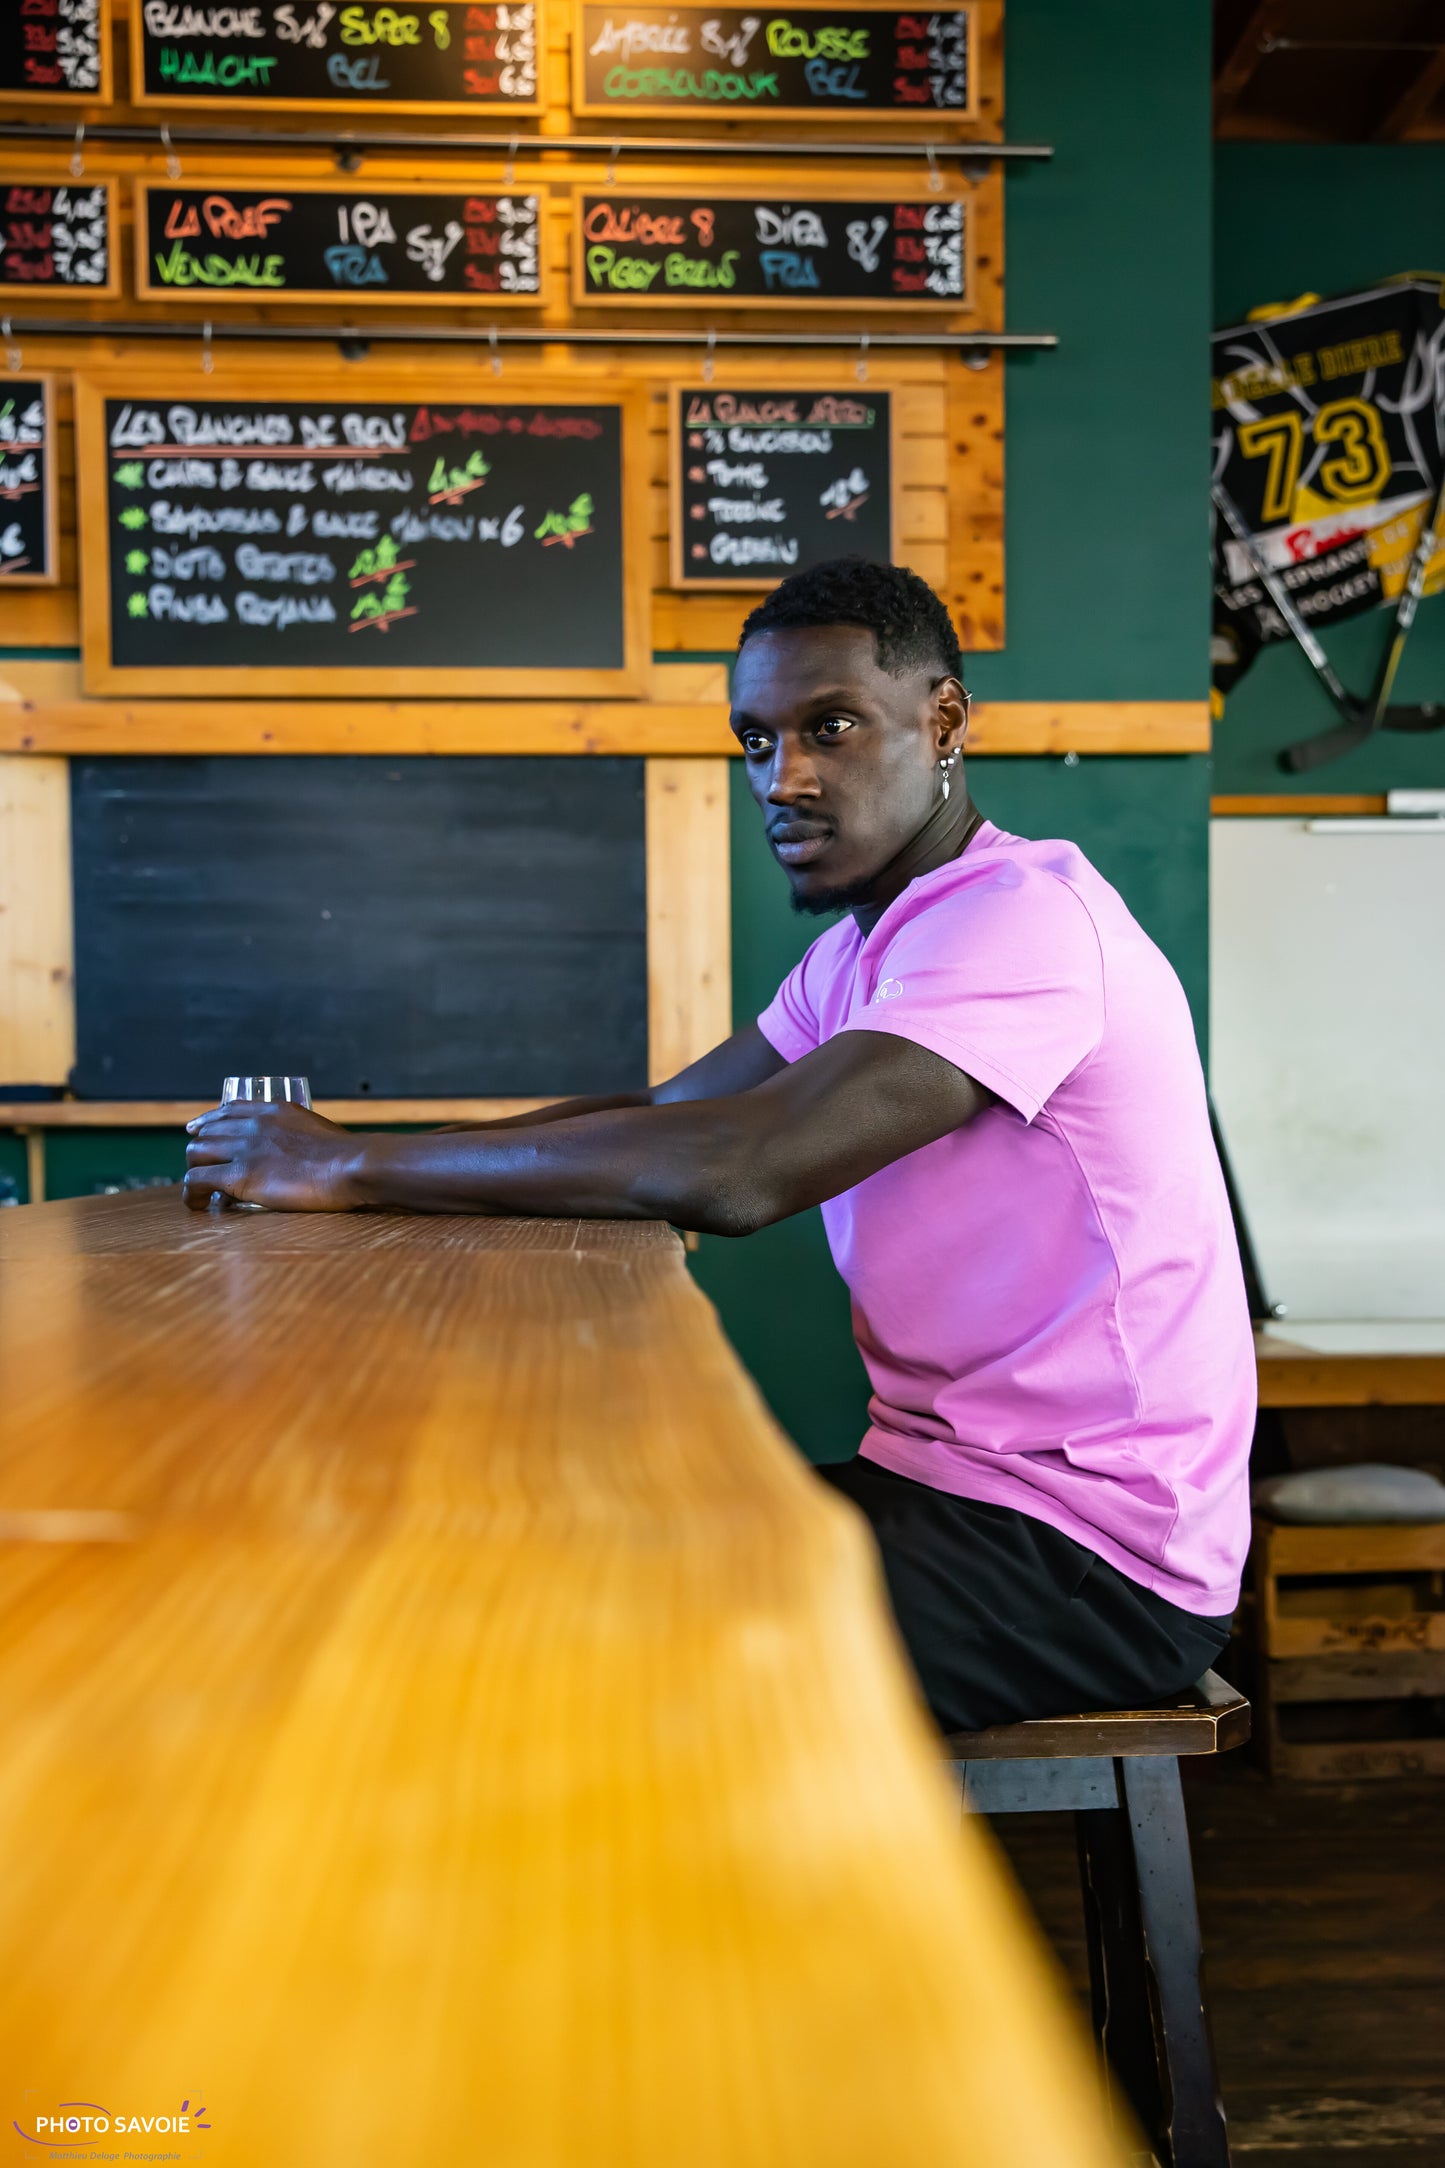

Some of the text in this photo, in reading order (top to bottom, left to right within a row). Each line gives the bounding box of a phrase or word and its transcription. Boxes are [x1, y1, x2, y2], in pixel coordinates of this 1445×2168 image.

[143, 1, 266, 37] BLANCHE
[429, 10, 450, 50] 8
[766, 18, 870, 61] ROUSSE
[338, 201, 397, 248] IPA
[690, 207, 715, 247] 8
[110, 403, 165, 447] LES
[1238, 396, 1396, 522] 73
